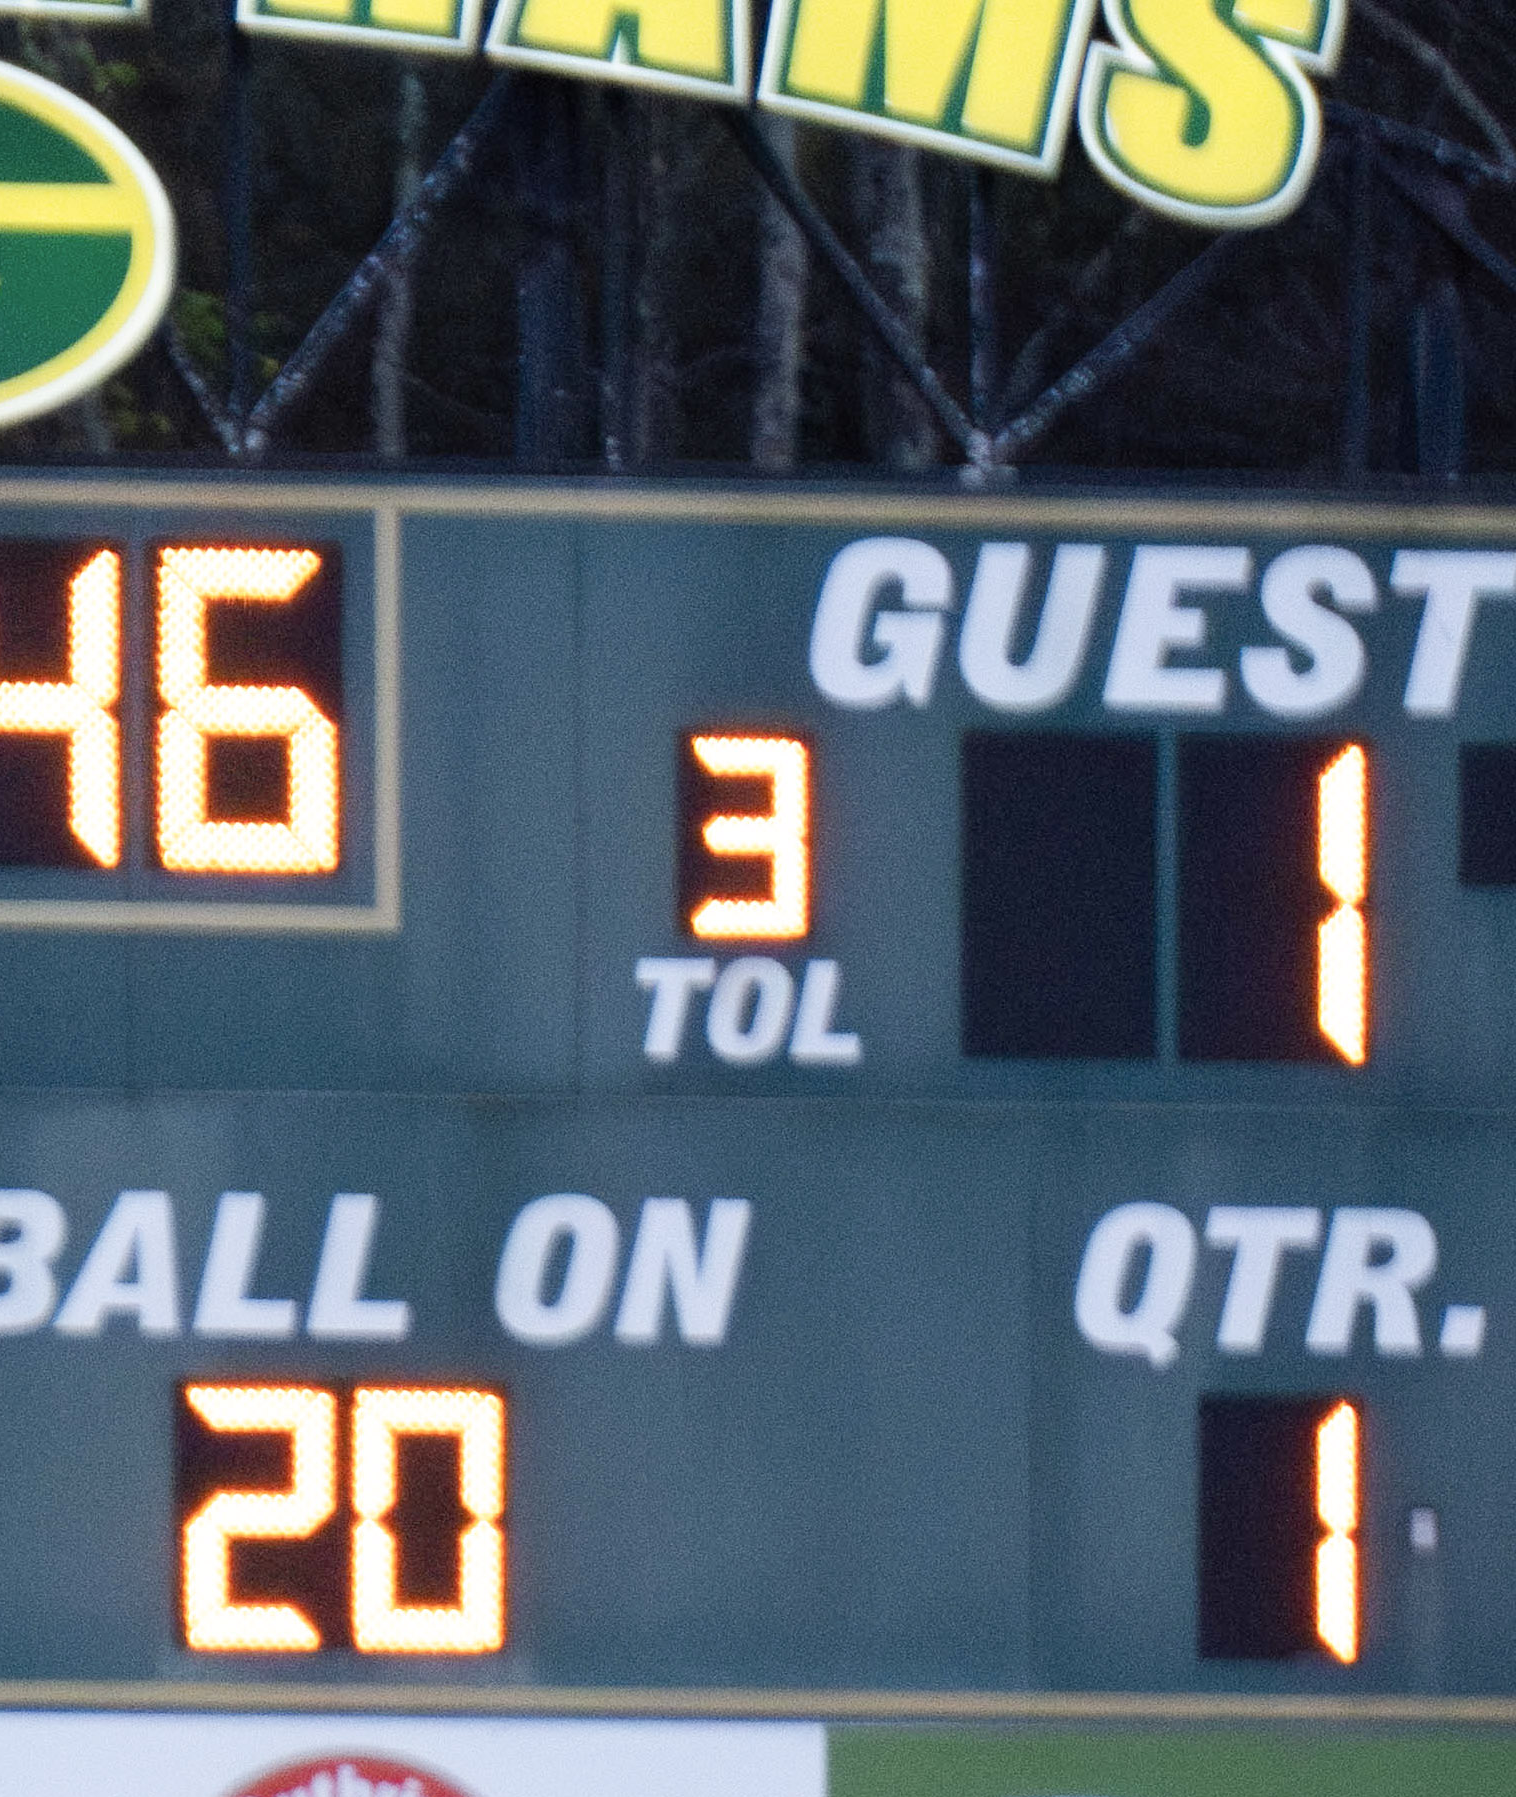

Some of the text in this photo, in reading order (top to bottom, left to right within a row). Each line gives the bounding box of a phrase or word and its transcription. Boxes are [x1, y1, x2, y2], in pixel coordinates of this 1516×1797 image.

[809, 536, 1516, 718] GUEST
[690, 735, 811, 940] 3
[1316, 743, 1368, 1067] 1
[634, 957, 861, 1063] TOL
[494, 1192, 752, 1347] ON
[1075, 1200, 1485, 1370] QTR.
[182, 1384, 506, 1655] 20
[1316, 1398, 1360, 1665] 1
